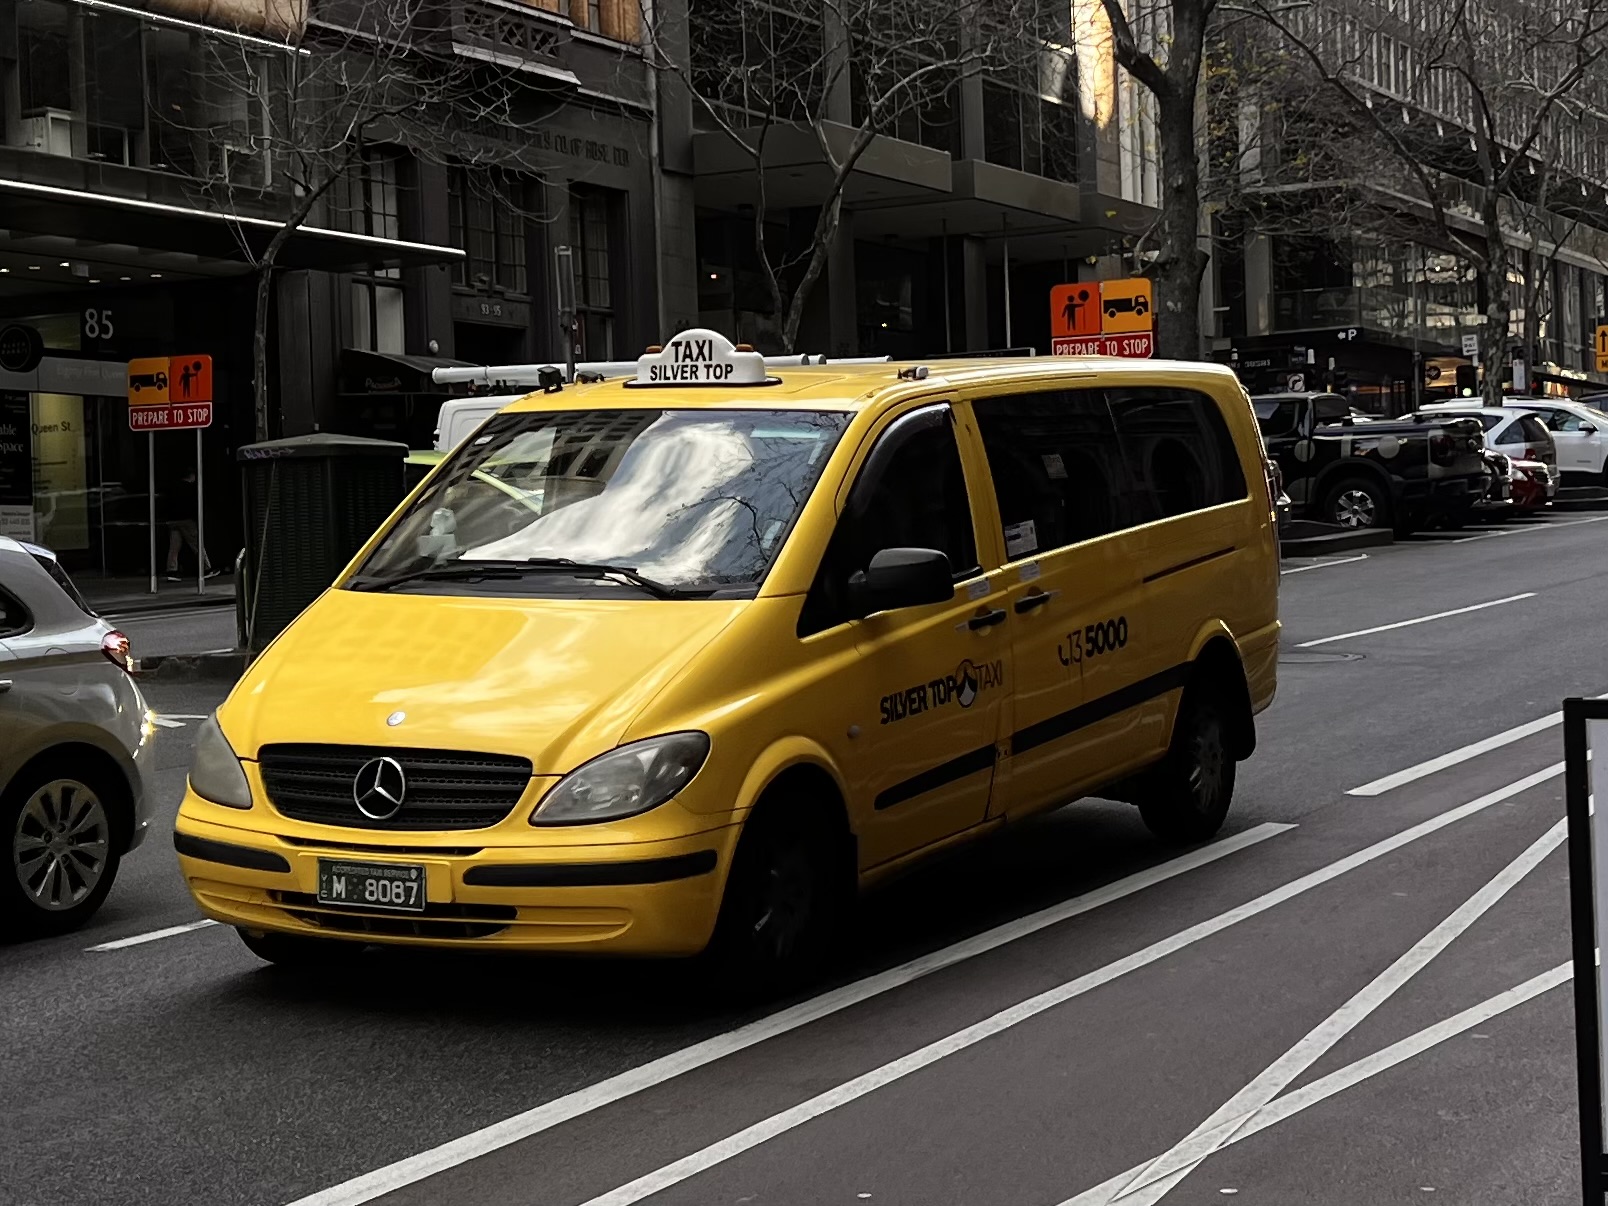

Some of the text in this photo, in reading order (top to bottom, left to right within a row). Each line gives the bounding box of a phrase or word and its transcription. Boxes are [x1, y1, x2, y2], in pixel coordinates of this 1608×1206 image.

[85, 308, 114, 340] 85
[1347, 328, 1357, 341] P
[671, 339, 713, 363] TAXI
[1056, 338, 1149, 356] PREPARE TO STOP
[650, 363, 734, 381] SILVER TOP
[132, 407, 209, 426] PREPARE TO STOP
[32, 421, 71, 436] Queen St
[1085, 616, 1127, 658] 5000
[880, 659, 1003, 725] SILVER TOP TAXI
[332, 875, 418, 905] M 8087
